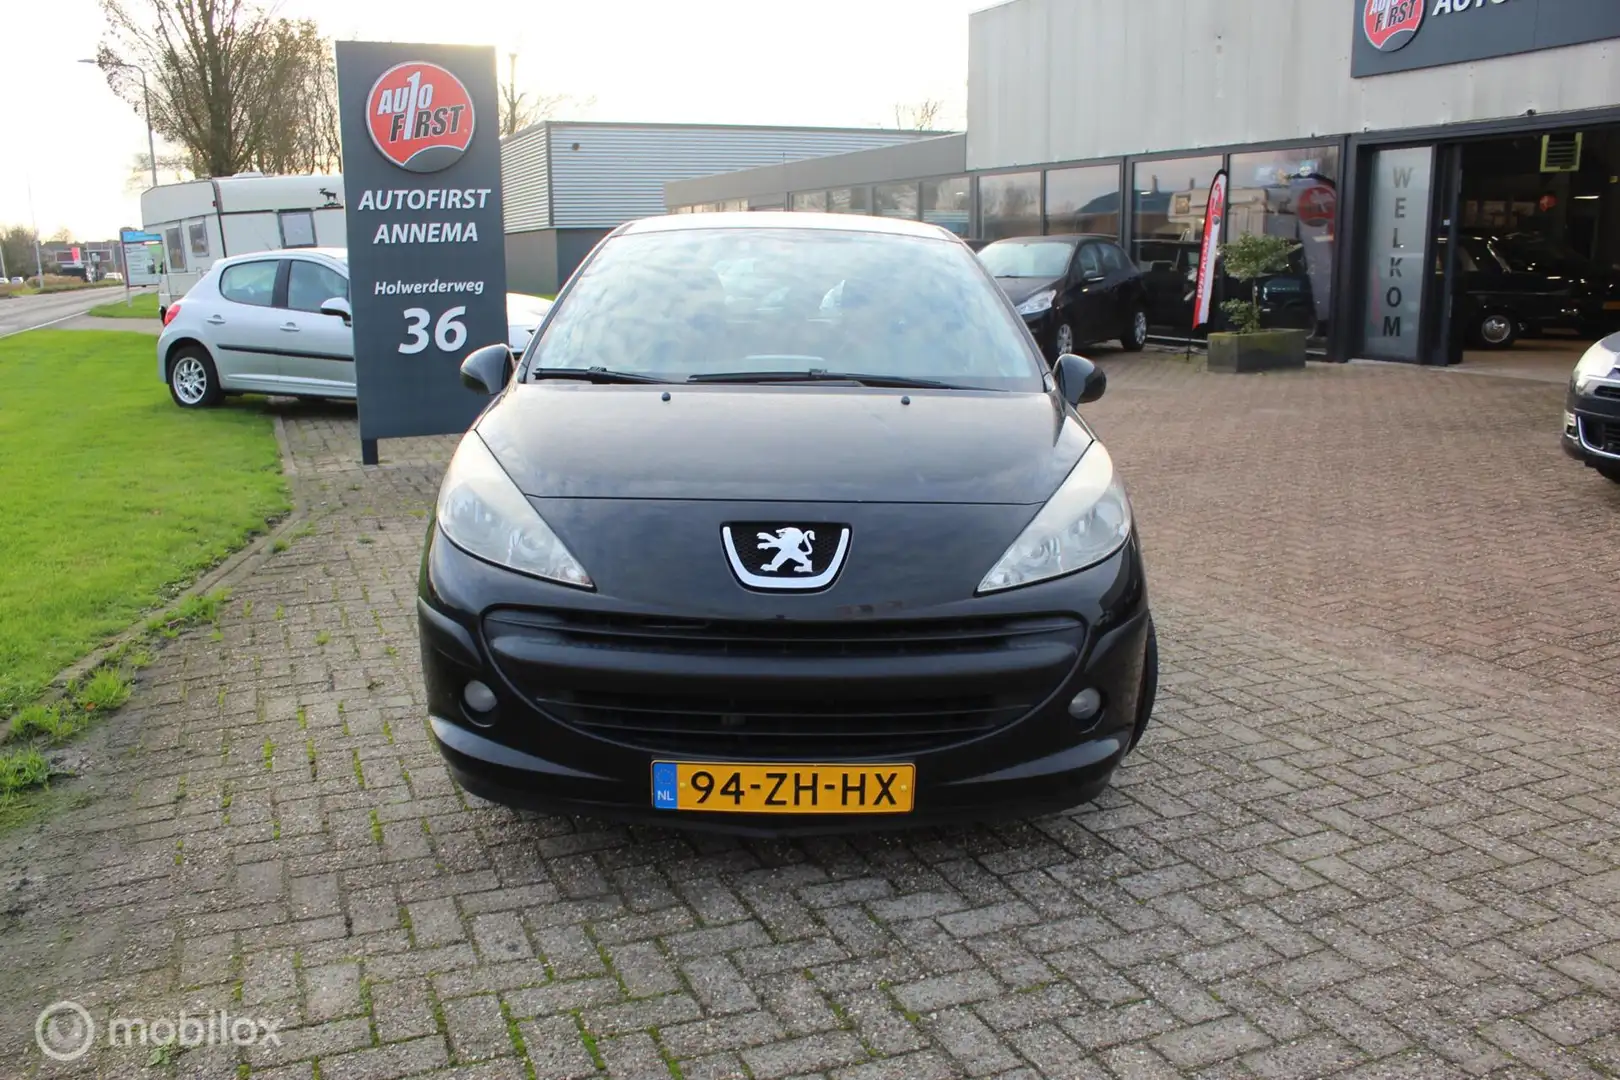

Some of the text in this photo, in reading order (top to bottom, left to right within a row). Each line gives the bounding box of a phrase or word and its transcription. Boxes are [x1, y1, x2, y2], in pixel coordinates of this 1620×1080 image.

[389, 104, 466, 143] FIRST
[357, 188, 492, 211] AUTOFIRST
[373, 222, 478, 245] ANNEMA
[1383, 167, 1414, 337] WELKOM
[374, 278, 484, 296] Holwerderweg
[398, 306, 467, 354] 36
[657, 771, 898, 806] NL 94-ZH-HX
